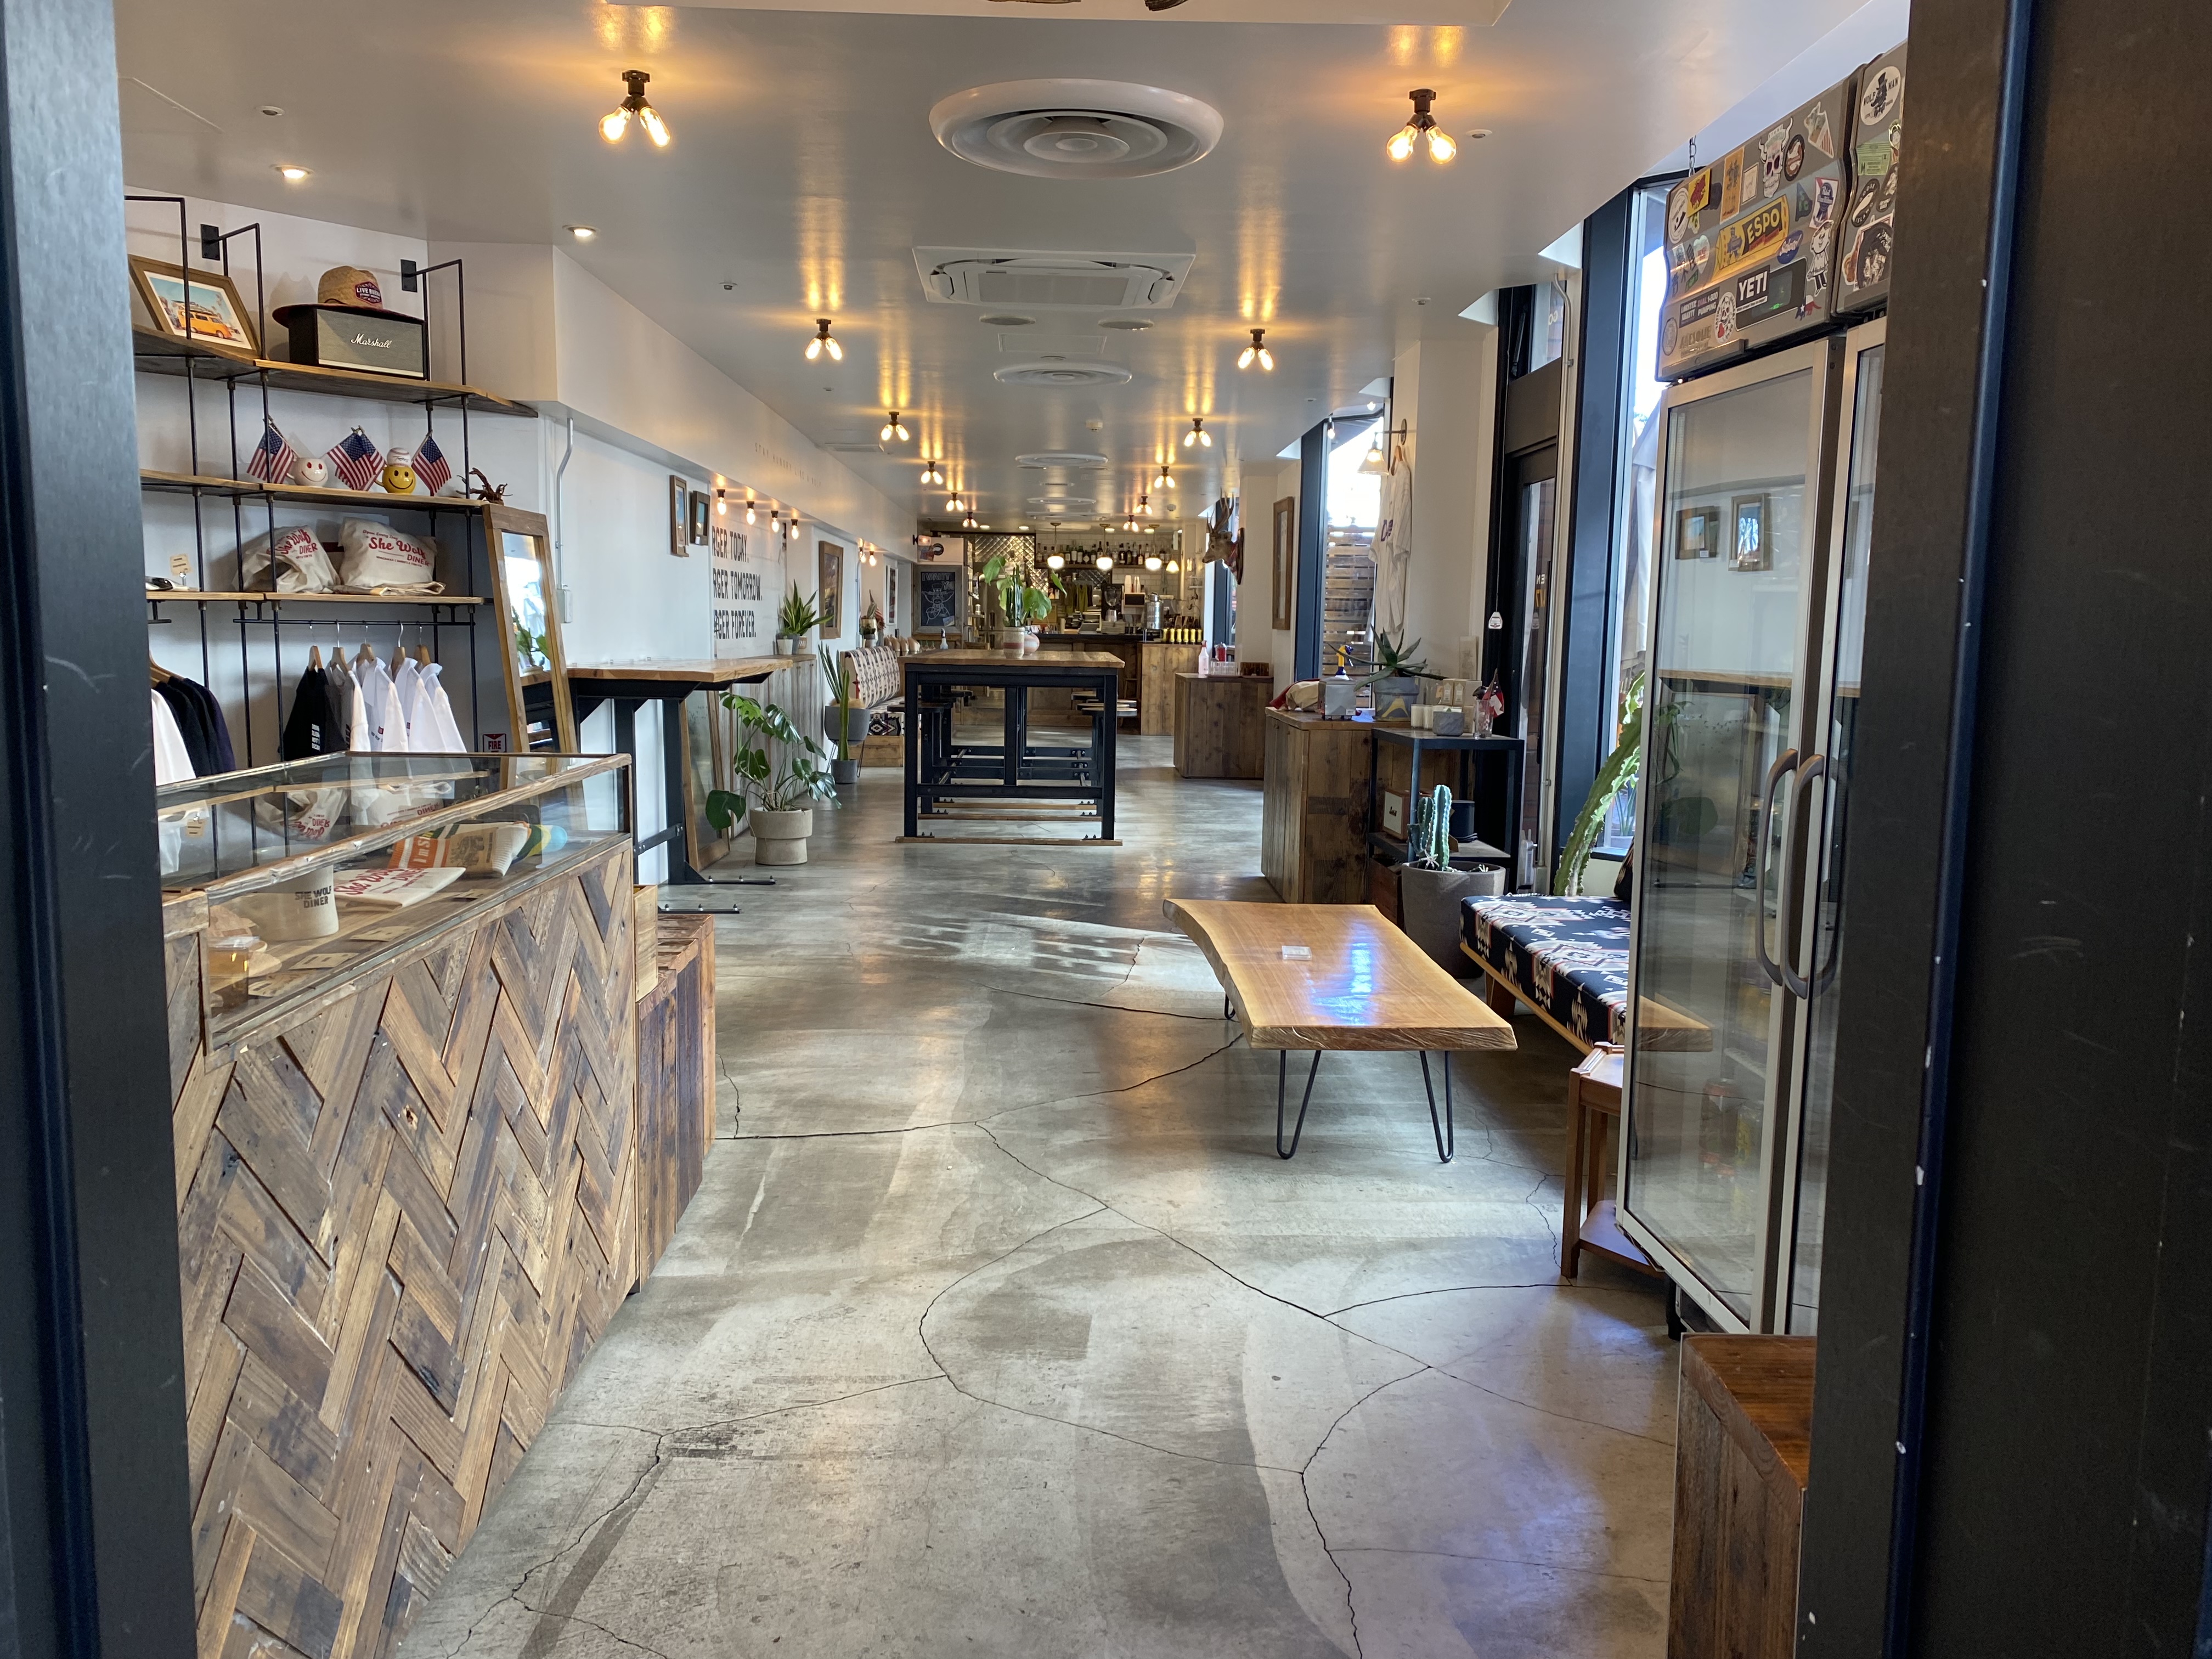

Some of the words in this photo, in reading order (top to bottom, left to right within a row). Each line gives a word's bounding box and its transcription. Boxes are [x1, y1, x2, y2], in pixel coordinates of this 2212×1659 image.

[1888, 77, 1899, 89] MAN
[1747, 208, 1780, 245] ESPO
[1739, 270, 1768, 301] YETI
[351, 333, 392, 348] Marshall
[299, 543, 318, 554] DINER
[368, 537, 394, 550] She
[396, 540, 426, 560] Wolf
[730, 531, 749, 563] TODAY.
[407, 554, 430, 567] DINER
[730, 571, 763, 601] TOMORROW.
[731, 610, 757, 639] FOREVER.
[488, 741, 501, 750] FIRE
[295, 891, 312, 900] SHE
[313, 885, 332, 898] WOLF
[303, 895, 329, 909] DINER
